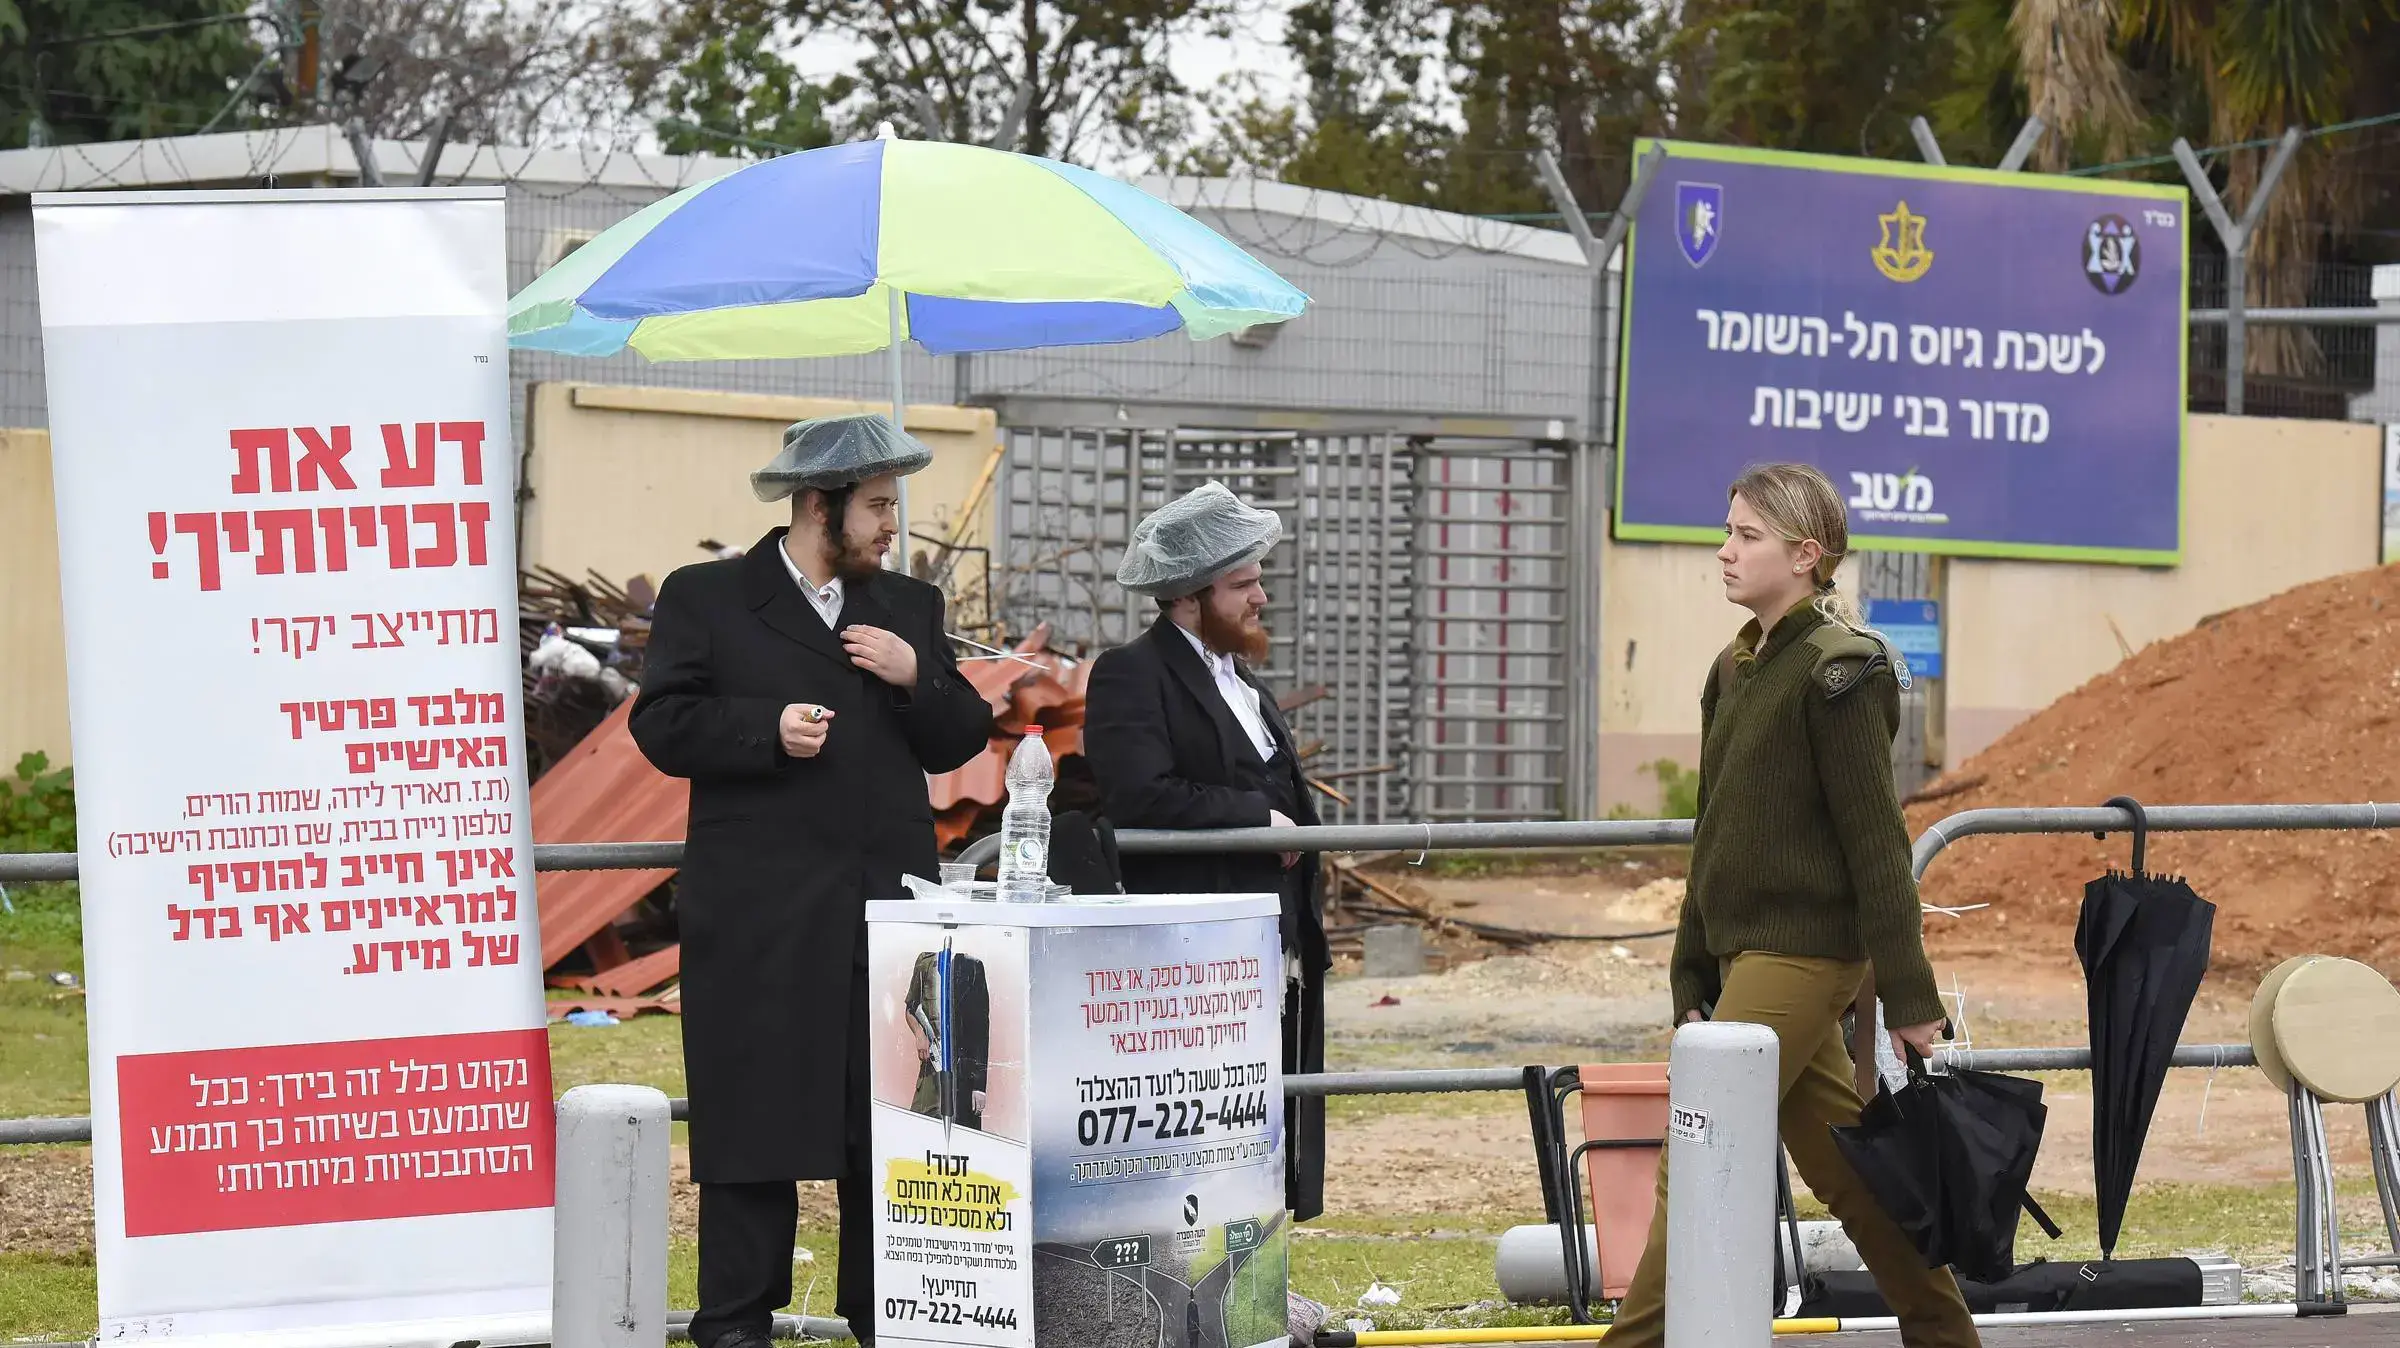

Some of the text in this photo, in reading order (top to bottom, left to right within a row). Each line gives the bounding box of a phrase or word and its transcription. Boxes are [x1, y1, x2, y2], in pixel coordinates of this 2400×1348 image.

[1697, 308, 2105, 376] לשכת גיוס תל-השומר
[1750, 385, 2050, 444] מדור בני ישיבות
[230, 421, 485, 494] דע את
[147, 502, 491, 592] זכויותיך!
[252, 607, 498, 660] מתייצב יקר!
[280, 688, 505, 741] מלבד פרטיך
[345, 736, 508, 774] האישיים
[182, 791, 251, 821] הורים,
[258, 789, 320, 814] שמות
[327, 782, 385, 814] לידה,
[390, 780, 461, 813] תאריך
[107, 808, 512, 859] טלפון נייח בבית, שם וכתובת הישיבה)
[187, 846, 516, 902] אינך חייב להוסיף
[167, 885, 517, 943] למראיינים אף בדל
[343, 930, 520, 975] של מידע.
[1085, 956, 1259, 997] בכל מקרה של ספק, או צורך
[1081, 1001, 1130, 1029] המשך
[1135, 998, 1177, 1025] בעניין
[1110, 1022, 1247, 1054] דחייתך משירות צבאי
[189, 1057, 528, 1108] נקוט כלל זה בידך: ככל
[1188, 1068, 1220, 1093] שעה
[1223, 1063, 1245, 1088] בכל
[1247, 1061, 1267, 1086] פנה
[150, 1099, 531, 1155] שתמעט בשיחה כך תמנע
[1078, 1090, 1267, 1146] 077-222-4444
[1674, 1109, 1706, 1129] למה
[217, 1142, 533, 1194] הסתבכויות מיותרות!
[925, 1149, 969, 1177] זכור!
[1123, 1158, 1142, 1177] הכן
[1145, 1153, 1179, 1172] העומד
[1181, 1149, 1215, 1168] מקצועי
[1216, 1146, 1235, 1163] צוות
[1070, 1158, 1120, 1181] לעזרתך.
[897, 1178, 1001, 1204] אתה לא חותם
[887, 1200, 1012, 1231] ולא מסכים כלום!
[886, 1234, 895, 1247] לך
[896, 1235, 922, 1248] טומנים
[959, 1242, 971, 1252] בני
[1114, 1241, 1139, 1263] ???
[907, 1251, 923, 1263] בפח
[924, 1252, 953, 1265] להפילך
[954, 1255, 983, 1268] ושקרים
[984, 1257, 1017, 1270] מלכודות
[922, 1274, 977, 1299] תתייעץ!
[885, 1298, 1017, 1330] 077-222-4444
